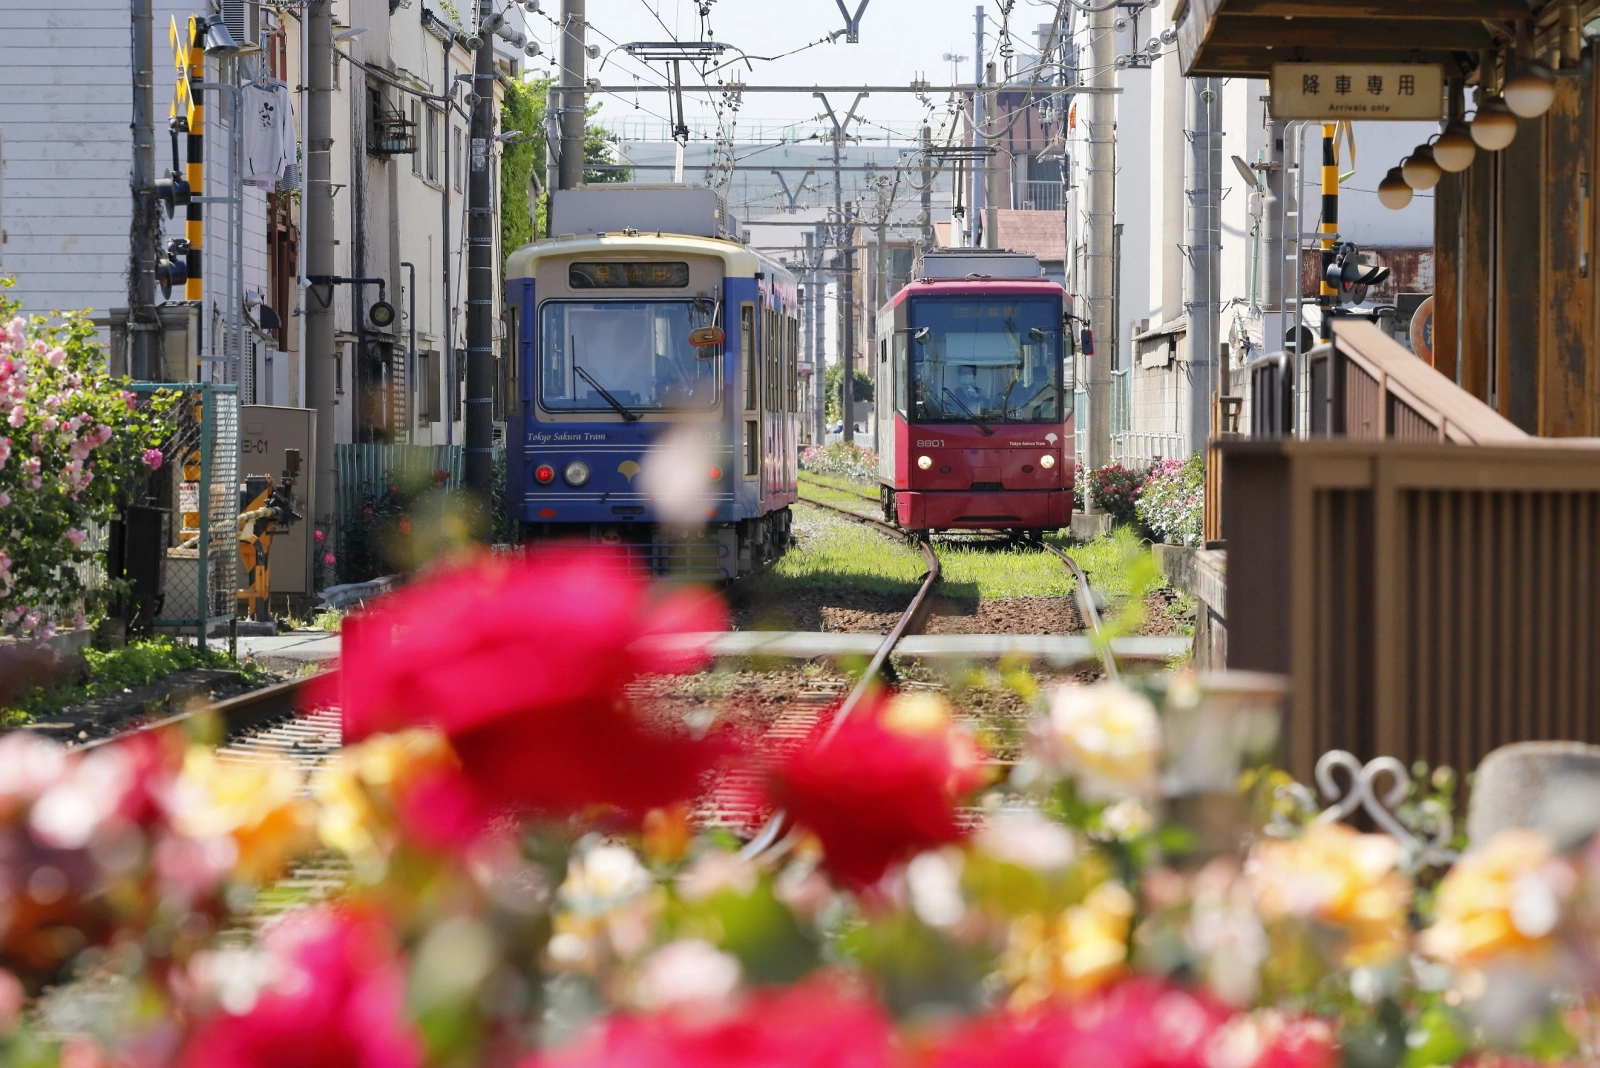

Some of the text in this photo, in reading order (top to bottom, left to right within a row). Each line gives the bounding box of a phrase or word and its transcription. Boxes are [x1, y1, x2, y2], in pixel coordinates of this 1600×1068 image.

[1302, 74, 1415, 96] 降車専用
[1329, 104, 1390, 112] Arrivals only
[527, 432, 606, 444] Tokyo Sakura Tram
[917, 439, 945, 447] 8801
